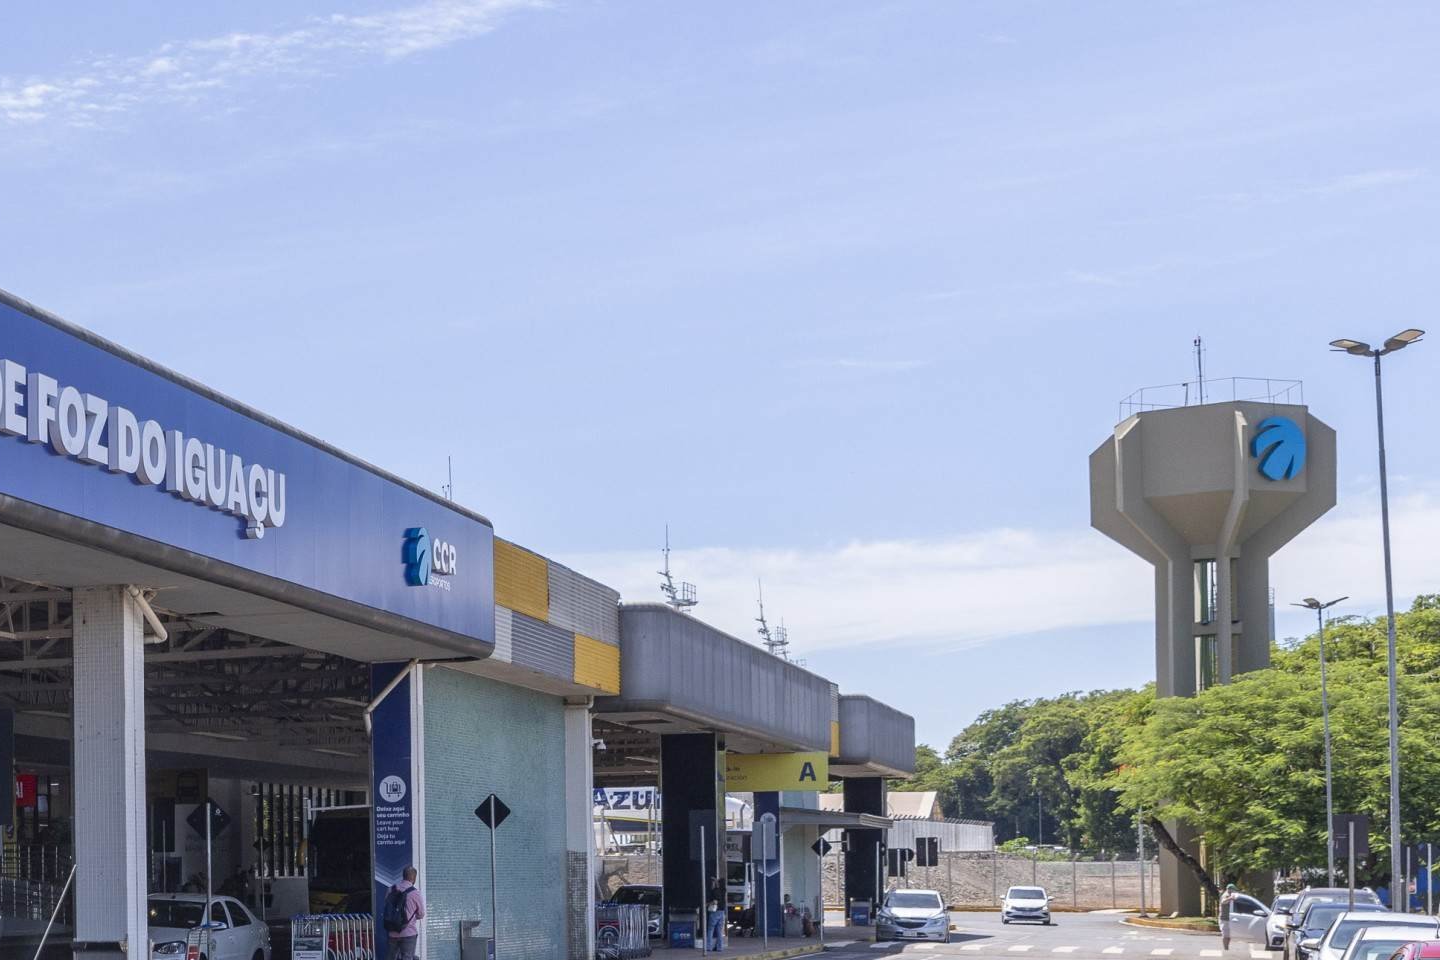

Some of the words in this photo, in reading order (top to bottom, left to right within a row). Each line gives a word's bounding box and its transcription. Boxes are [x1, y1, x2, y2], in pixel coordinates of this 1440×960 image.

[27, 373, 109, 465] FOZ
[109, 406, 166, 485] DO
[166, 430, 286, 540] IGUAÇU
[433, 538, 457, 575] CCR
[799, 761, 817, 782] A
